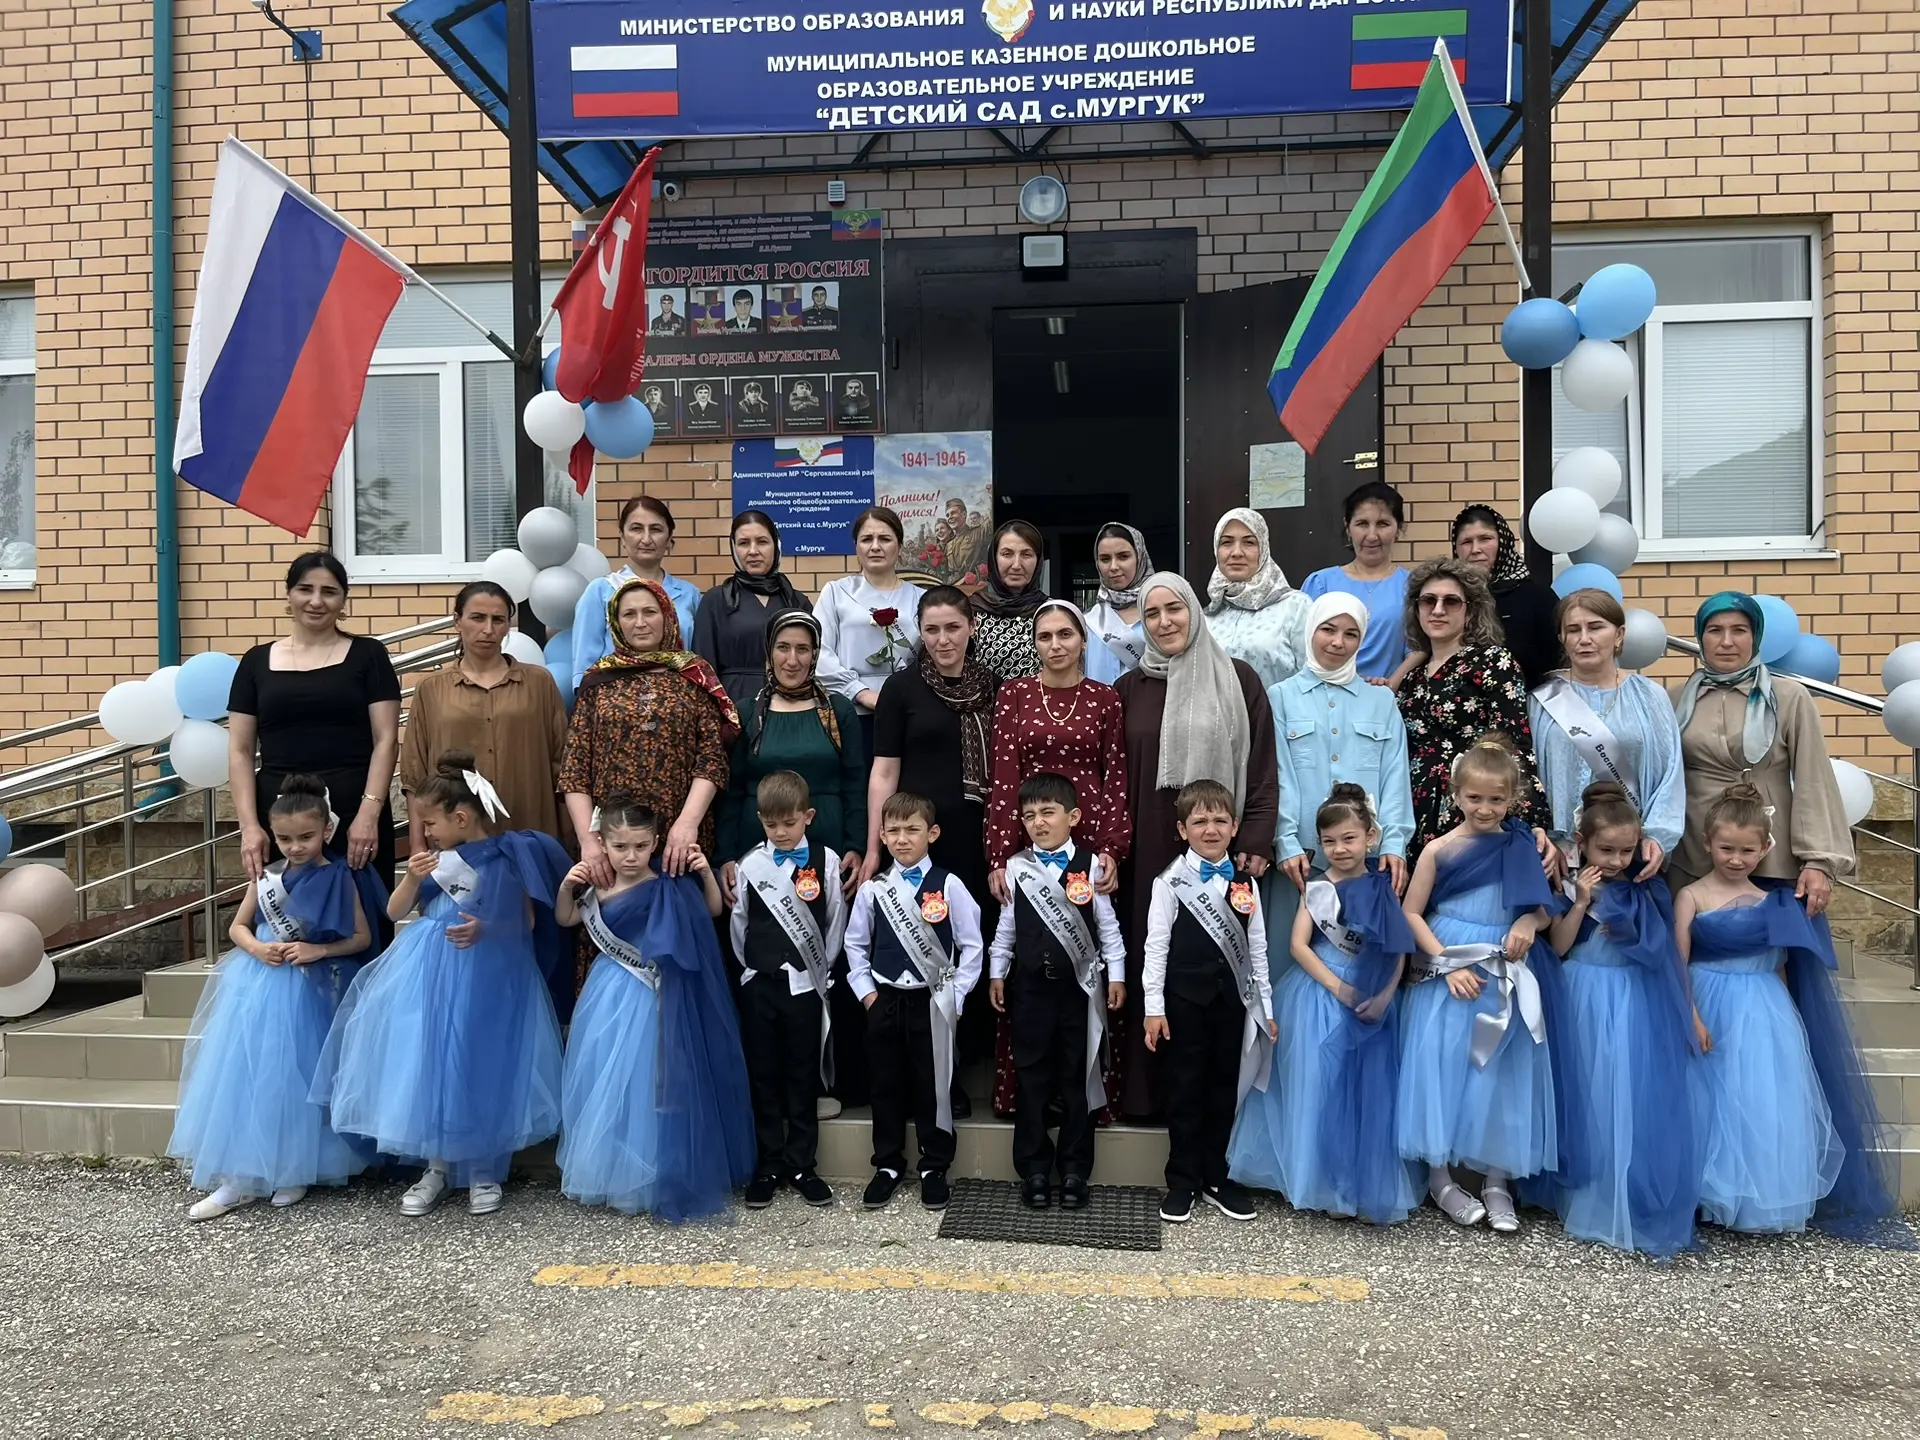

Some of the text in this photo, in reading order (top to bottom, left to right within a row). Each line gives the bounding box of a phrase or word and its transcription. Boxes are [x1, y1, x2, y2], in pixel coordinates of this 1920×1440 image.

[619, 15, 796, 37] МИНИСТЕРСТВО
[801, 9, 965, 31] ОБРАЗОВАНИЯ
[1049, 4, 1064, 20] И
[1071, 0, 1145, 19] НАУКИ
[766, 36, 1256, 74] МУНИЦИПАЛЬНОЕ КАЗЕННОЕ ДОШКОЛЬНОЕ
[816, 69, 1195, 99] ОБРАЗОВАТЕЛЬНОЕ УЧРЕЖДЕНИЕ
[816, 93, 1206, 130] “ДЕТСКИЙ САД с.МУРГУК”
[645, 258, 870, 287] ГОРДИТСЯ РОССИЯ
[644, 348, 841, 367] АЛЕРЫ ОРДЕНА МУЖЕСТВА
[900, 450, 967, 468] 1941-1945
[732, 471, 787, 479] Администрация
[861, 468, 874, 478] рай
[747, 498, 871, 507] дошкольное общеобразовательное
[765, 489, 854, 498] Муниципальное казенное
[878, 489, 941, 508] Помним!
[788, 506, 831, 514] учреждение
[896, 505, 939, 521] димся!
[773, 521, 802, 529] Детский
[802, 521, 816, 529] сад
[794, 544, 826, 553] с.Мургук
[266, 887, 301, 941] Выпуск
[886, 886, 933, 959] Выпускник
[1038, 885, 1089, 958] Выпускник
[780, 895, 822, 968] Выпускник
[1196, 892, 1244, 967] Выпускник
